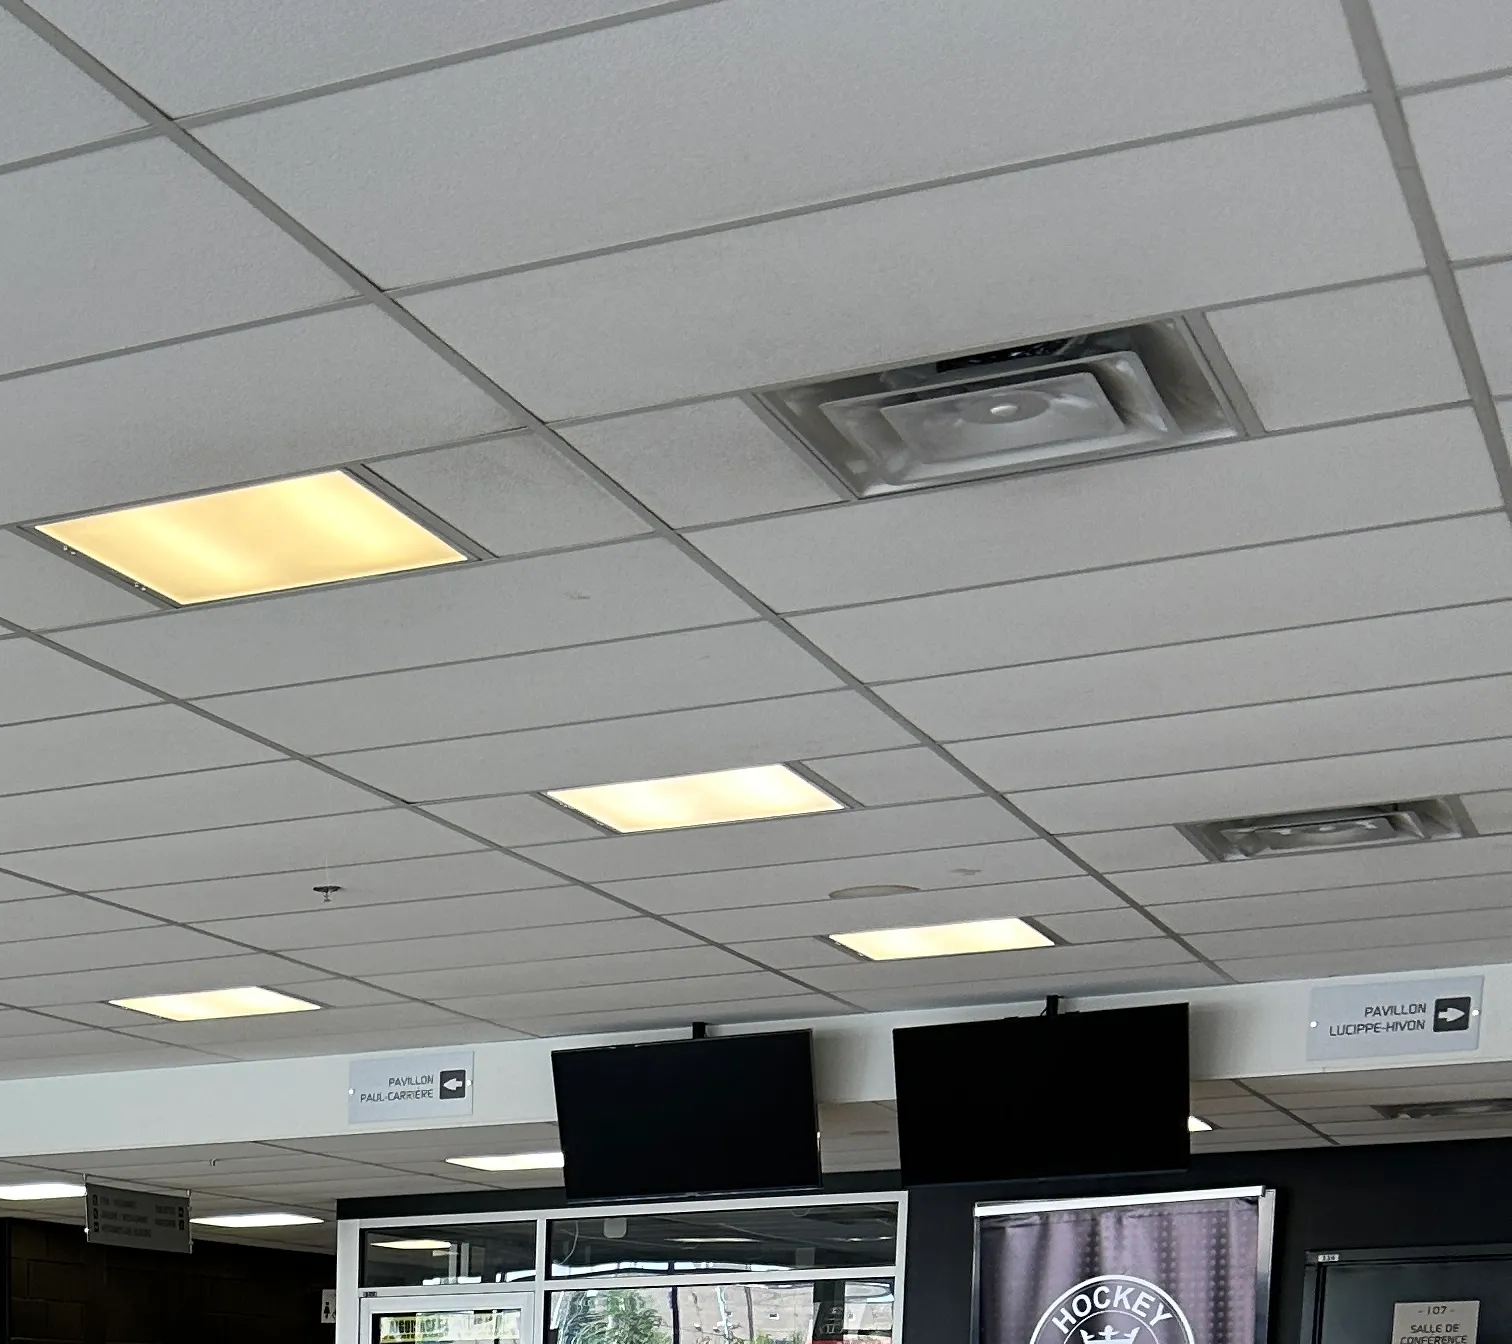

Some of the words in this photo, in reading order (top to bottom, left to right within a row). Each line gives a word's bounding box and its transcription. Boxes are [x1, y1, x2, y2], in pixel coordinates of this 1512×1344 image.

[1364, 1003, 1427, 1018] PAVILLON
[388, 1074, 434, 1087] PAVILLON
[1051, 1285, 1174, 1335] HOCKEY
[1427, 1306, 1448, 1315] 107
[1410, 1323, 1442, 1334] SALLE
[1445, 1323, 1460, 1333] DE
